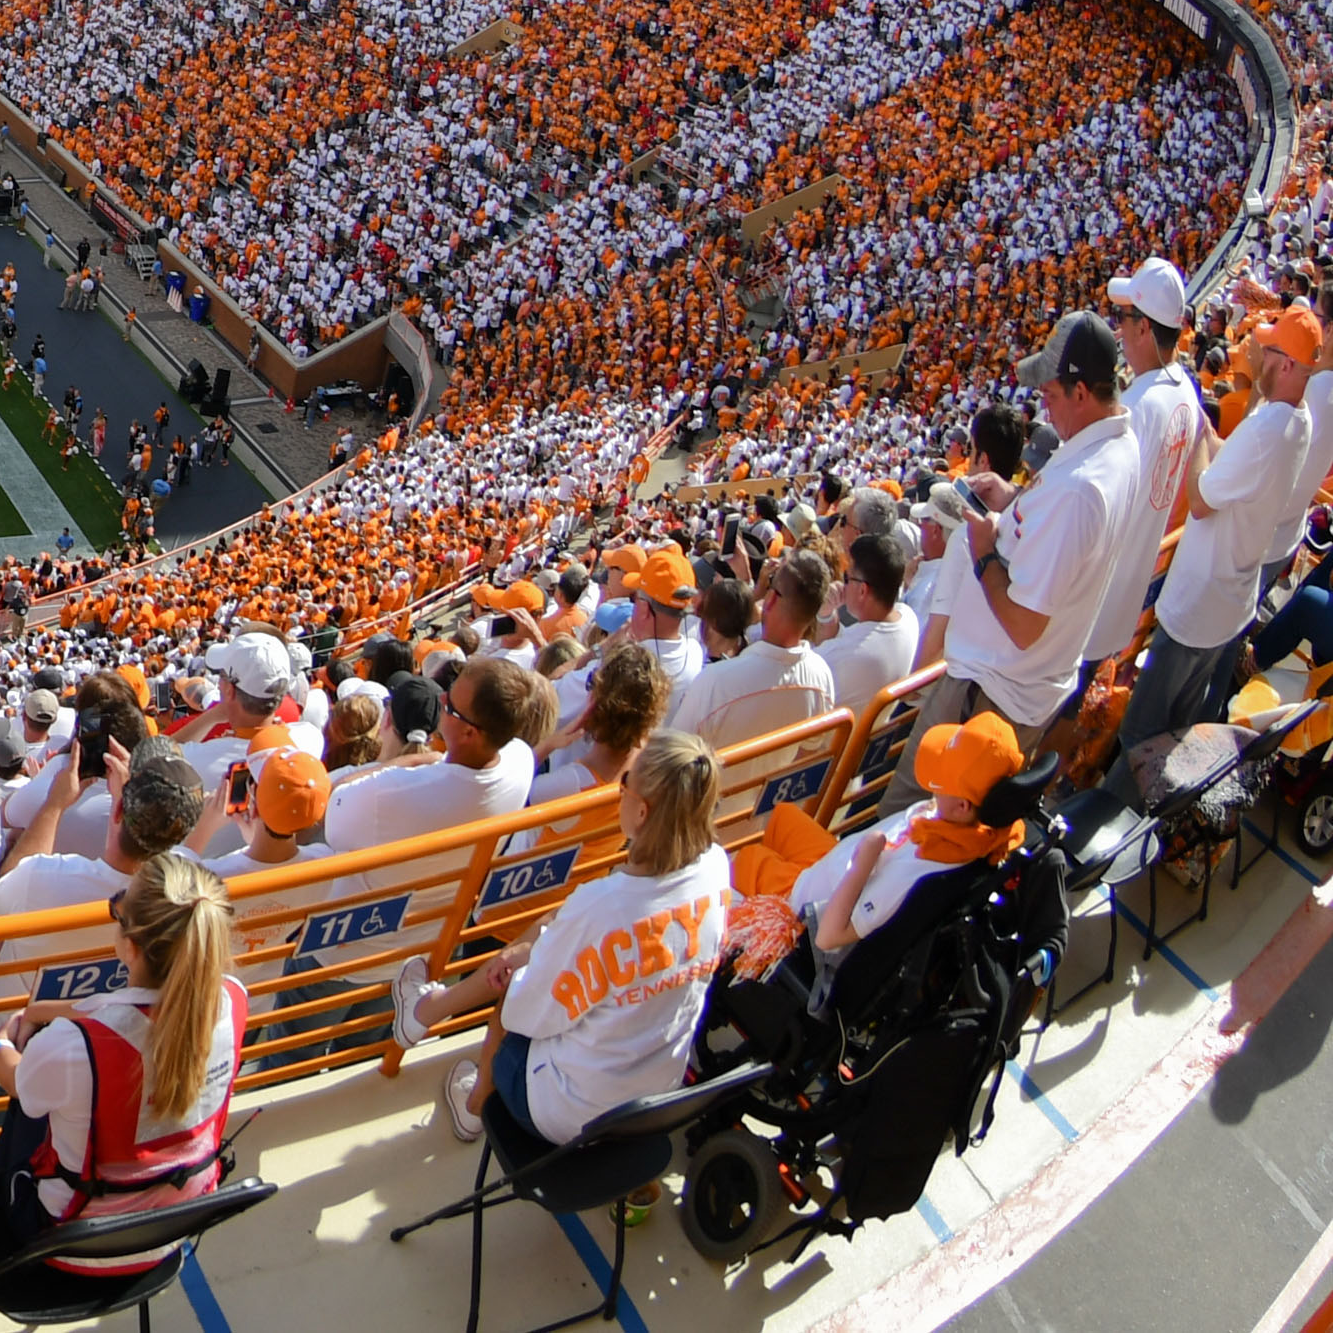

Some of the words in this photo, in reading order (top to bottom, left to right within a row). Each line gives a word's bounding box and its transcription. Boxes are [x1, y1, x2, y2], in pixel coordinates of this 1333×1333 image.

[776, 779, 792, 805] 8
[499, 866, 534, 900] 10
[320, 911, 351, 943] 11
[551, 895, 710, 1022] ROCKY
[57, 966, 101, 998] 12
